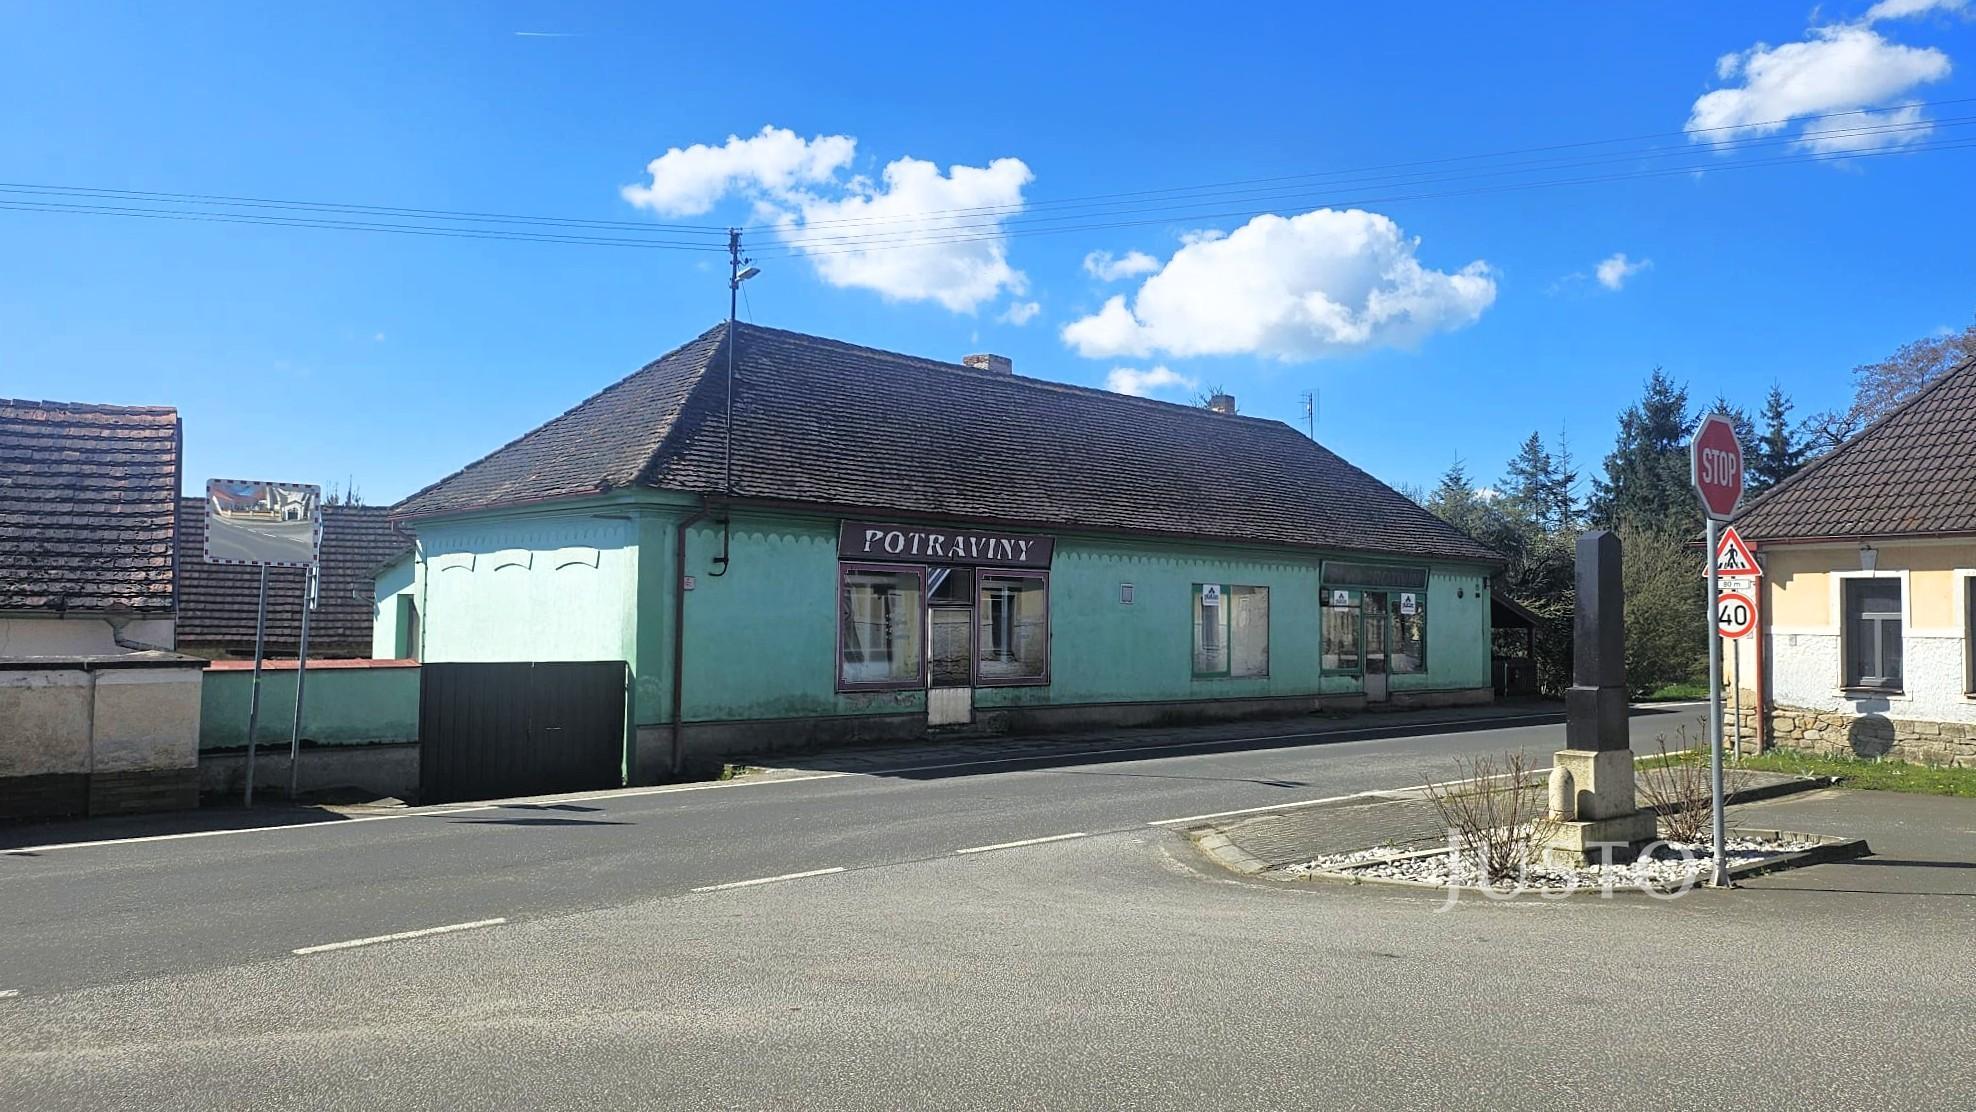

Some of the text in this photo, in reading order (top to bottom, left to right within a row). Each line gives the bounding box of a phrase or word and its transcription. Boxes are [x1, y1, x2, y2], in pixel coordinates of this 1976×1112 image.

[1702, 447, 1737, 488] STOP
[863, 530, 1035, 561] POTRAVINY
[1719, 605, 1747, 626] 40
